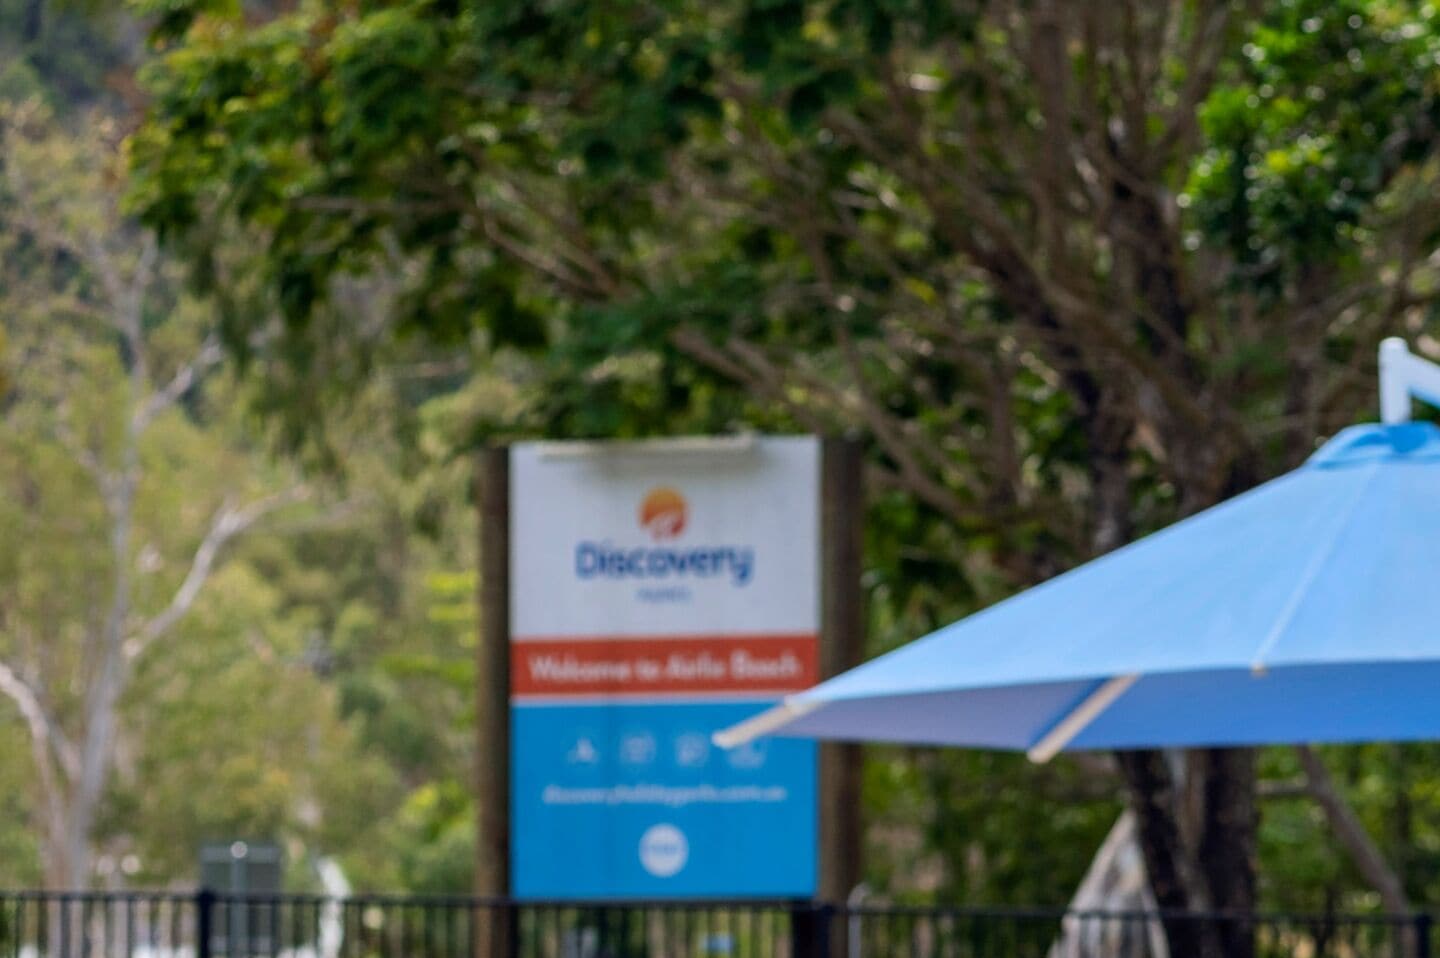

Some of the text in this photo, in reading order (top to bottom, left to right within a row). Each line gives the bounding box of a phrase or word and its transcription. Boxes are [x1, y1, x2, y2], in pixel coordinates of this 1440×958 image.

[575, 541, 754, 586] Discovery
[529, 653, 630, 682] Welcome
[635, 656, 661, 680] to
[730, 647, 801, 678] Beach
